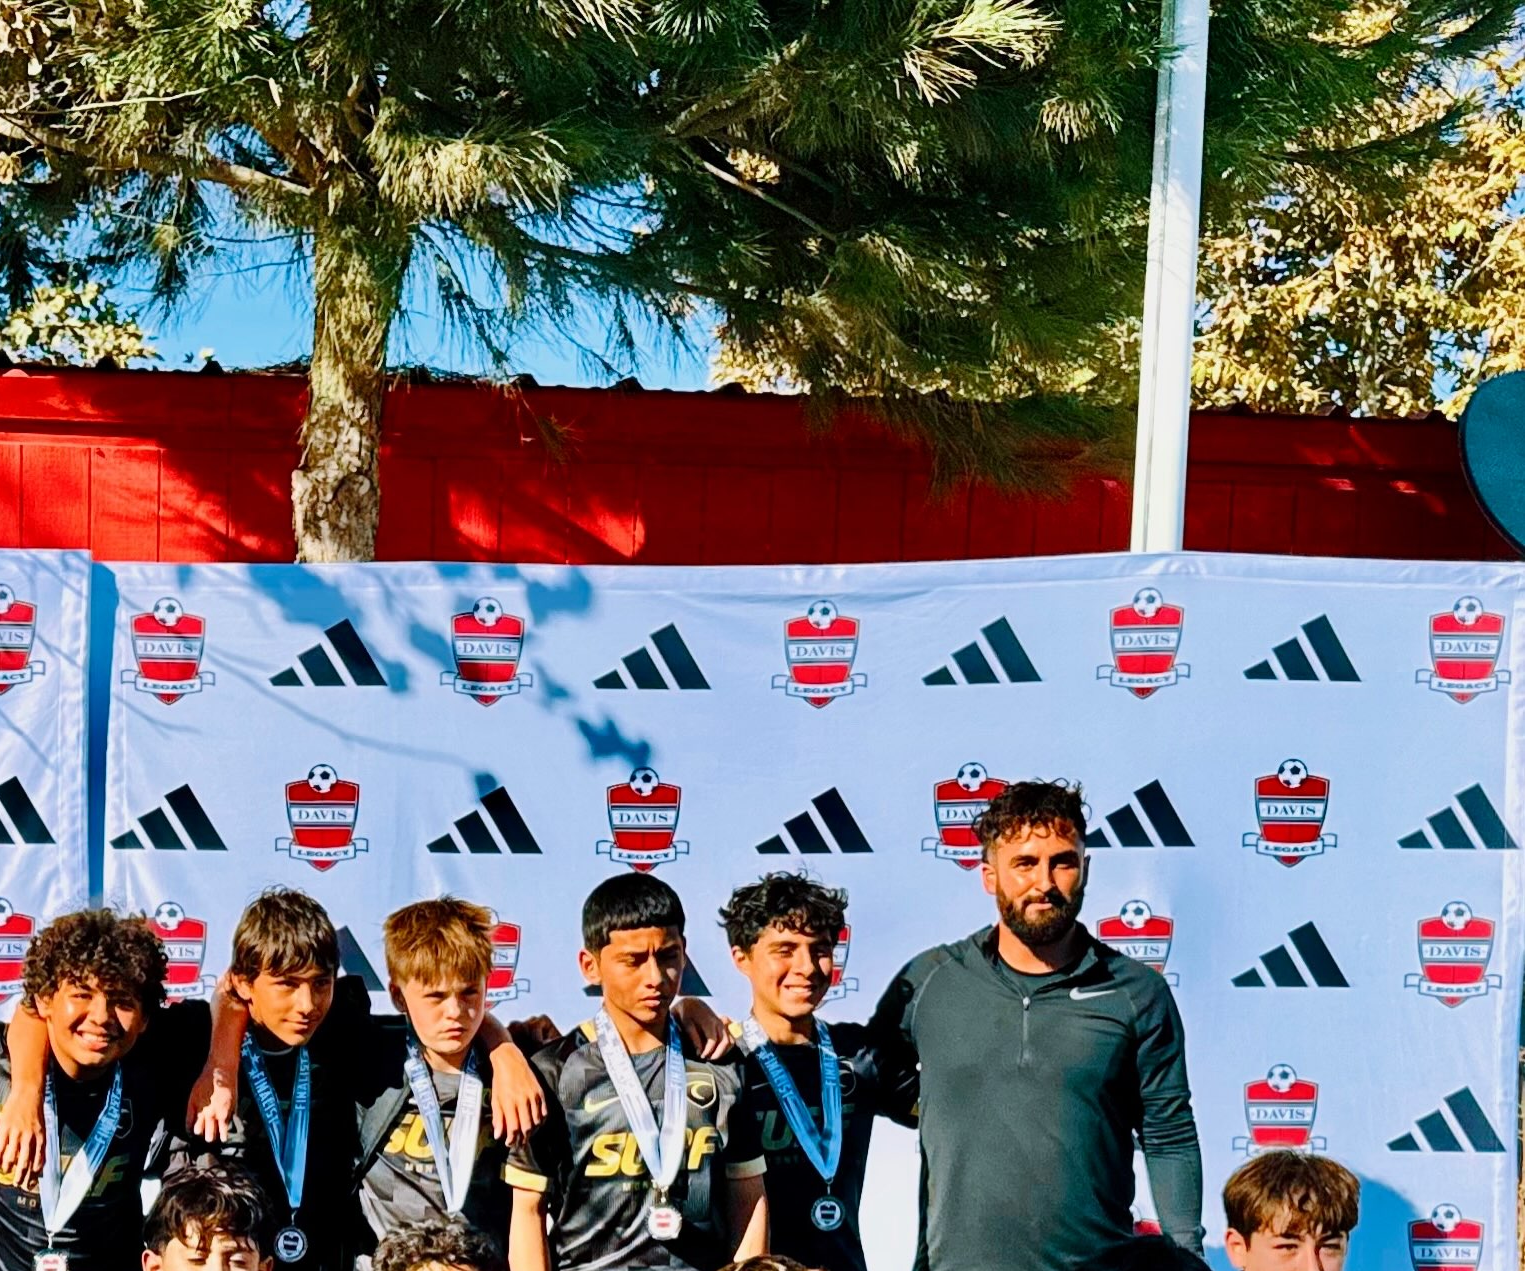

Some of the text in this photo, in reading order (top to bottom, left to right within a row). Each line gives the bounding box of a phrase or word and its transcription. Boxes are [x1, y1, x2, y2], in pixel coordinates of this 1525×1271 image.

[1121, 635, 1171, 645] DAVIS
[143, 642, 192, 652] DAVIS
[463, 643, 512, 654] DAVIS
[796, 646, 845, 657] DAVIS
[1440, 641, 1490, 652] DAVIS
[1118, 676, 1170, 684] LEGACY
[143, 682, 195, 690] LEGACY
[461, 683, 513, 691] LEGACY
[795, 687, 848, 695] LEGACY
[1437, 682, 1490, 690] LEGACY
[298, 810, 347, 820] DAVIS
[1267, 806, 1315, 816] DAVIS
[619, 813, 668, 822] DAVIS
[943, 848, 978, 856] LEGA
[1265, 845, 1317, 853] LEGACY
[618, 852, 670, 860] LEGACY
[1429, 946, 1480, 956] DAVIS
[1426, 986, 1480, 994] LEGACY
[763, 1052, 794, 1099] FINALIST
[295, 1057, 309, 1110] FINALIST
[252, 1070, 280, 1125] FINALIST
[1256, 1108, 1306, 1119] DAVIS
[585, 1126, 718, 1177] SUF
[1421, 1248, 1471, 1258] DAVIS
